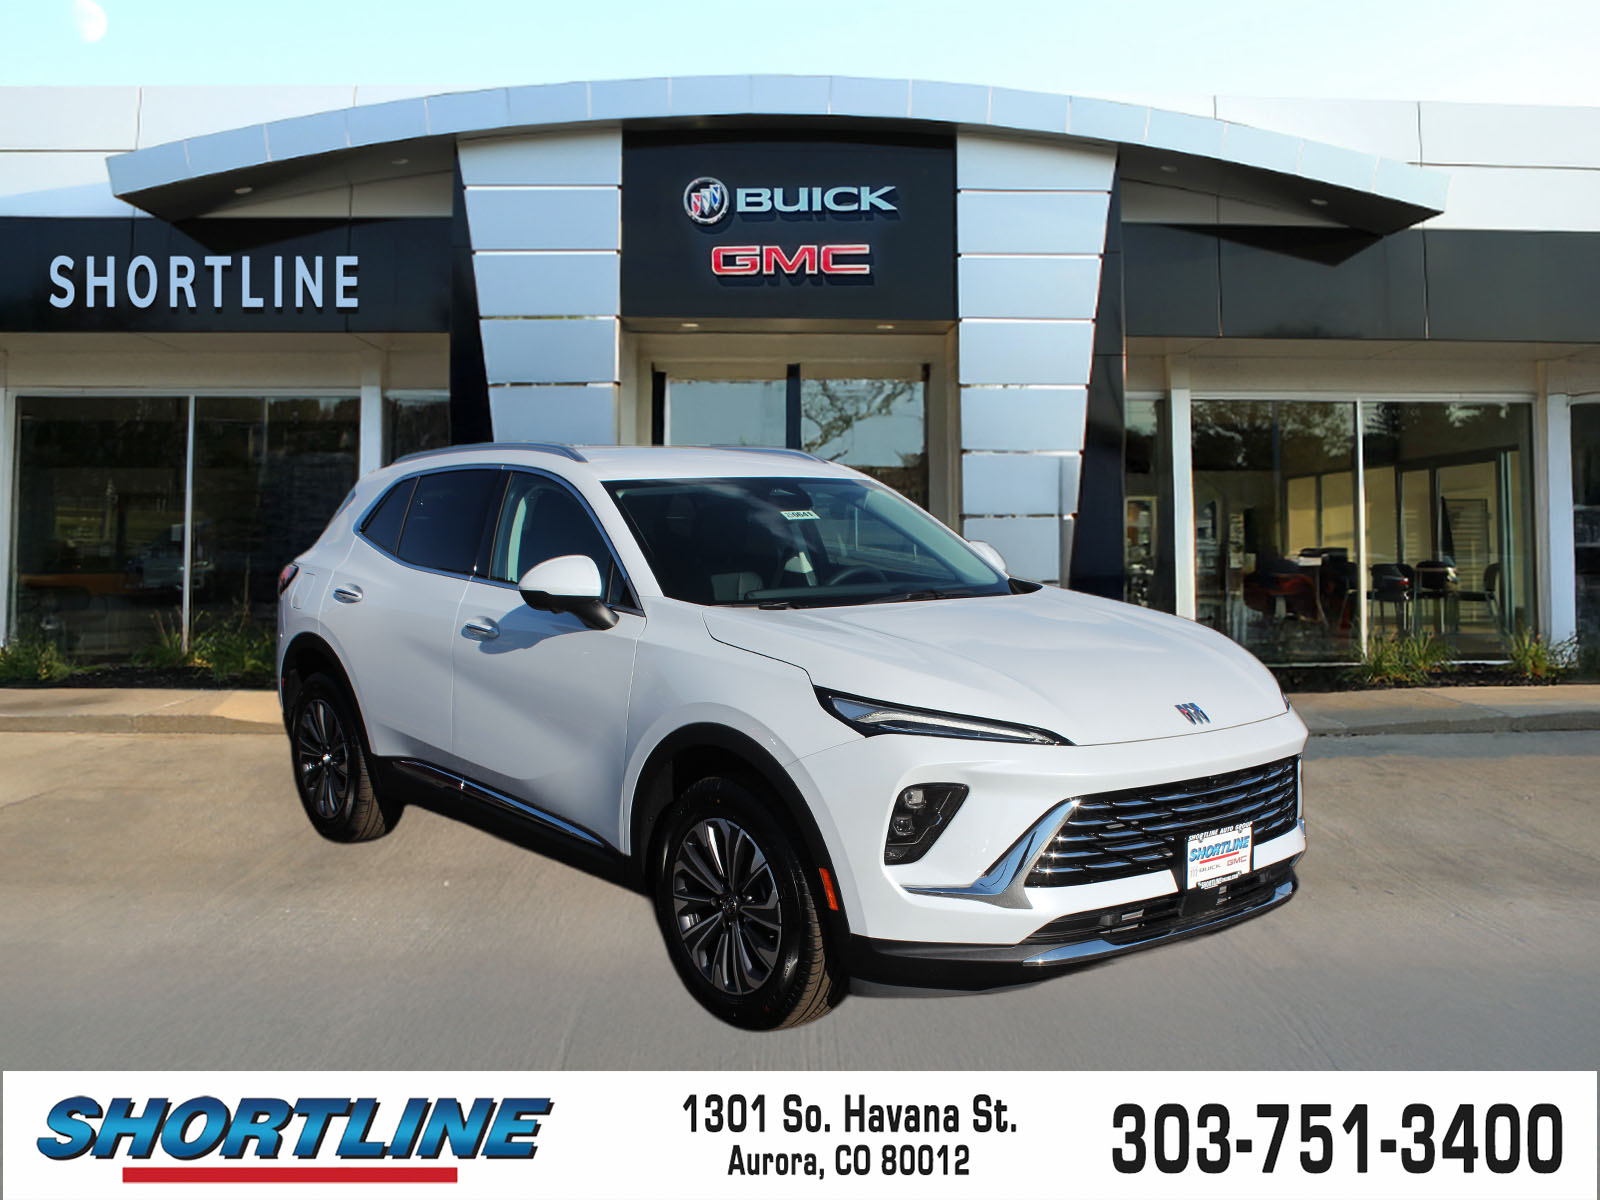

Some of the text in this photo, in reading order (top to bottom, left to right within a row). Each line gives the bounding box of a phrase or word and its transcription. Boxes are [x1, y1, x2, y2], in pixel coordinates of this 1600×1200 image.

[736, 186, 898, 213] BUICK
[711, 244, 870, 275] GMC
[49, 255, 359, 309] SHORTLINE
[1220, 825, 1234, 834] AUTO
[1189, 836, 1250, 862] SHORTLINE
[1227, 855, 1247, 866] GMC
